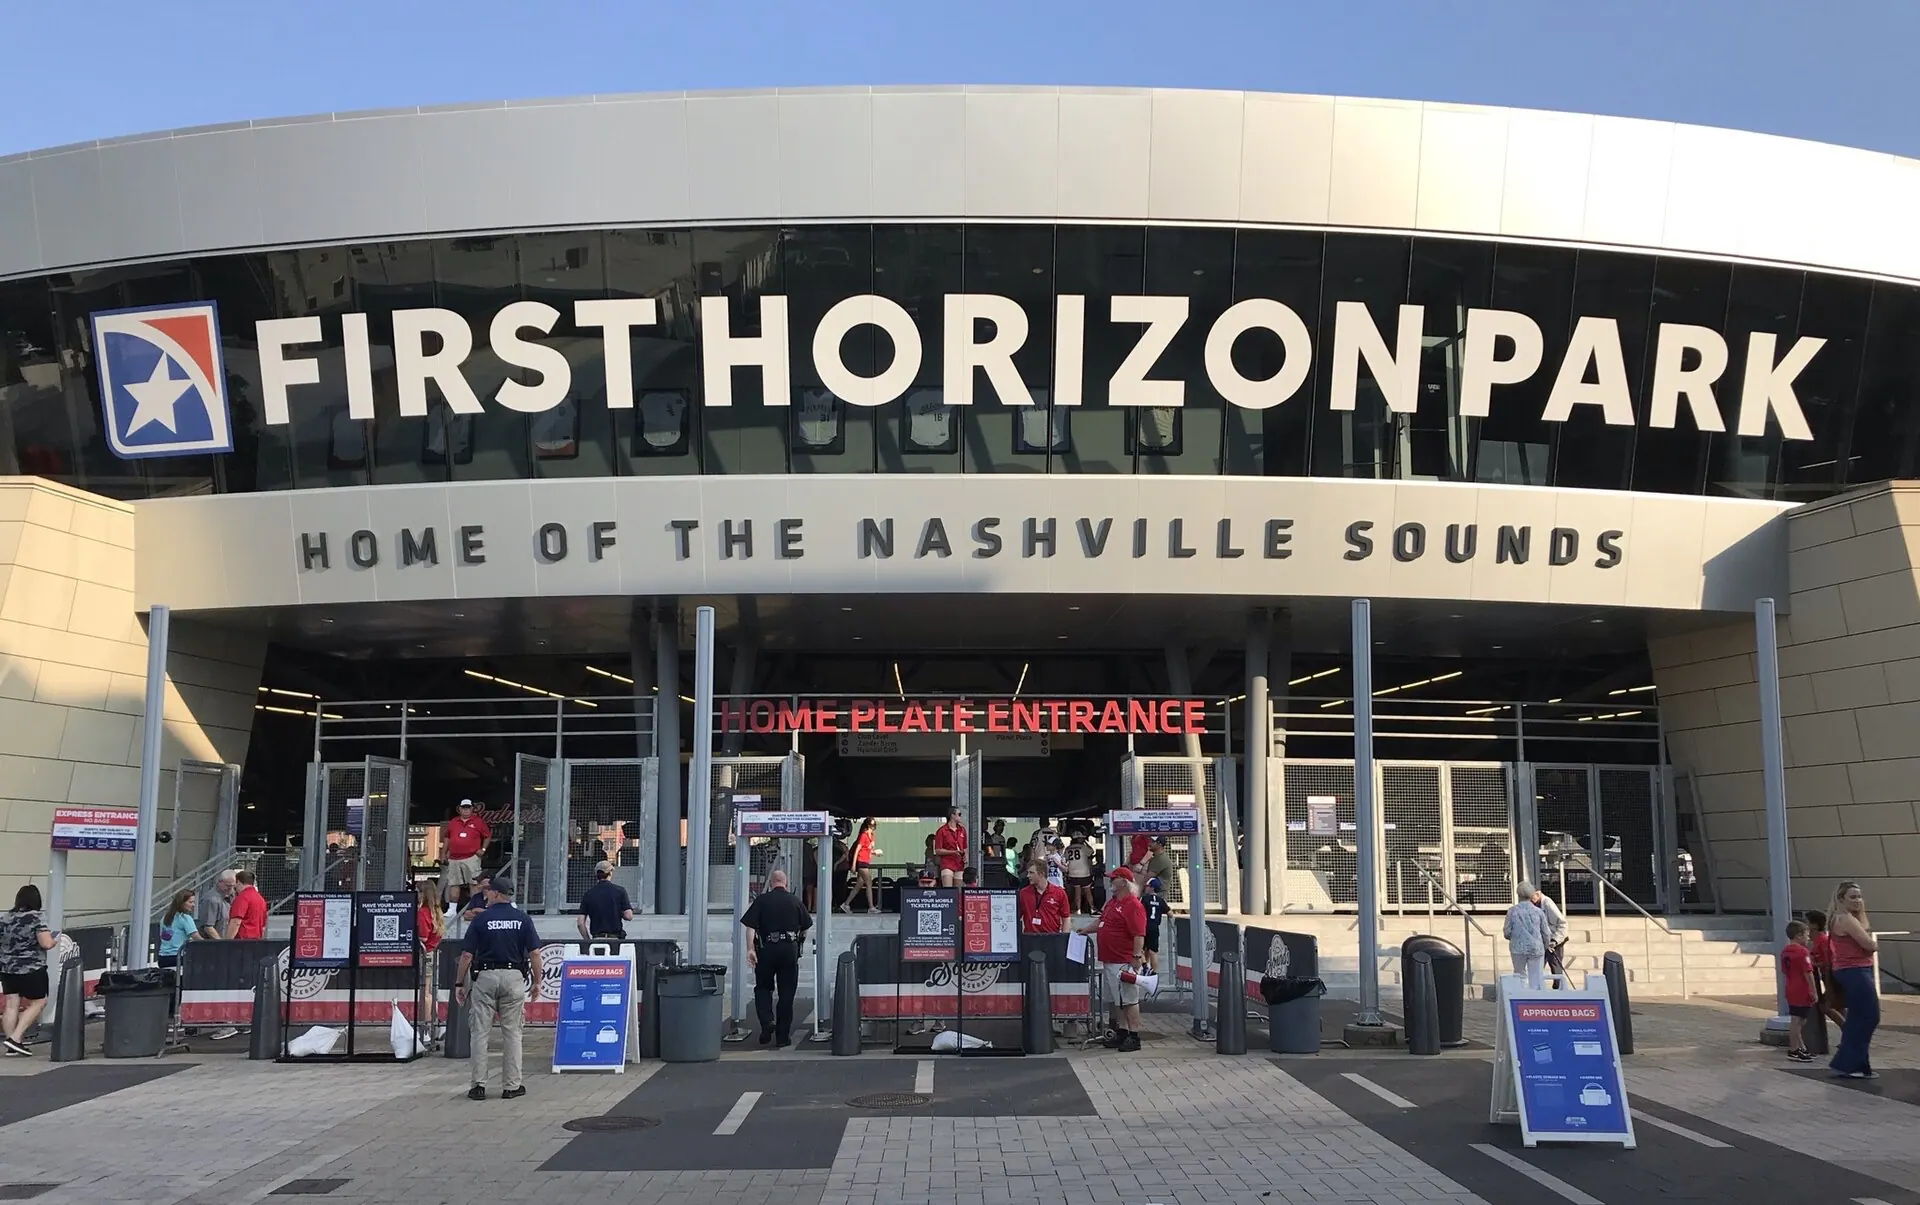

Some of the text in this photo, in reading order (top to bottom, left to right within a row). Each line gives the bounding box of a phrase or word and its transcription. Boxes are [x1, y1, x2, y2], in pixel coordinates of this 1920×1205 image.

[255, 293, 1828, 441] FIRST HORIZON PARK
[301, 517, 1623, 570] HOME OF THE NASHVILLE SOUNDS
[720, 699, 1206, 734] HOME PLATE ENTRANCE
[56, 810, 138, 820] EXPRESS ENTRANCE
[1067, 850, 1081, 860] 28
[487, 920, 522, 930] SECURITY
[1523, 1009, 1595, 1017] APPROVED BAGS
